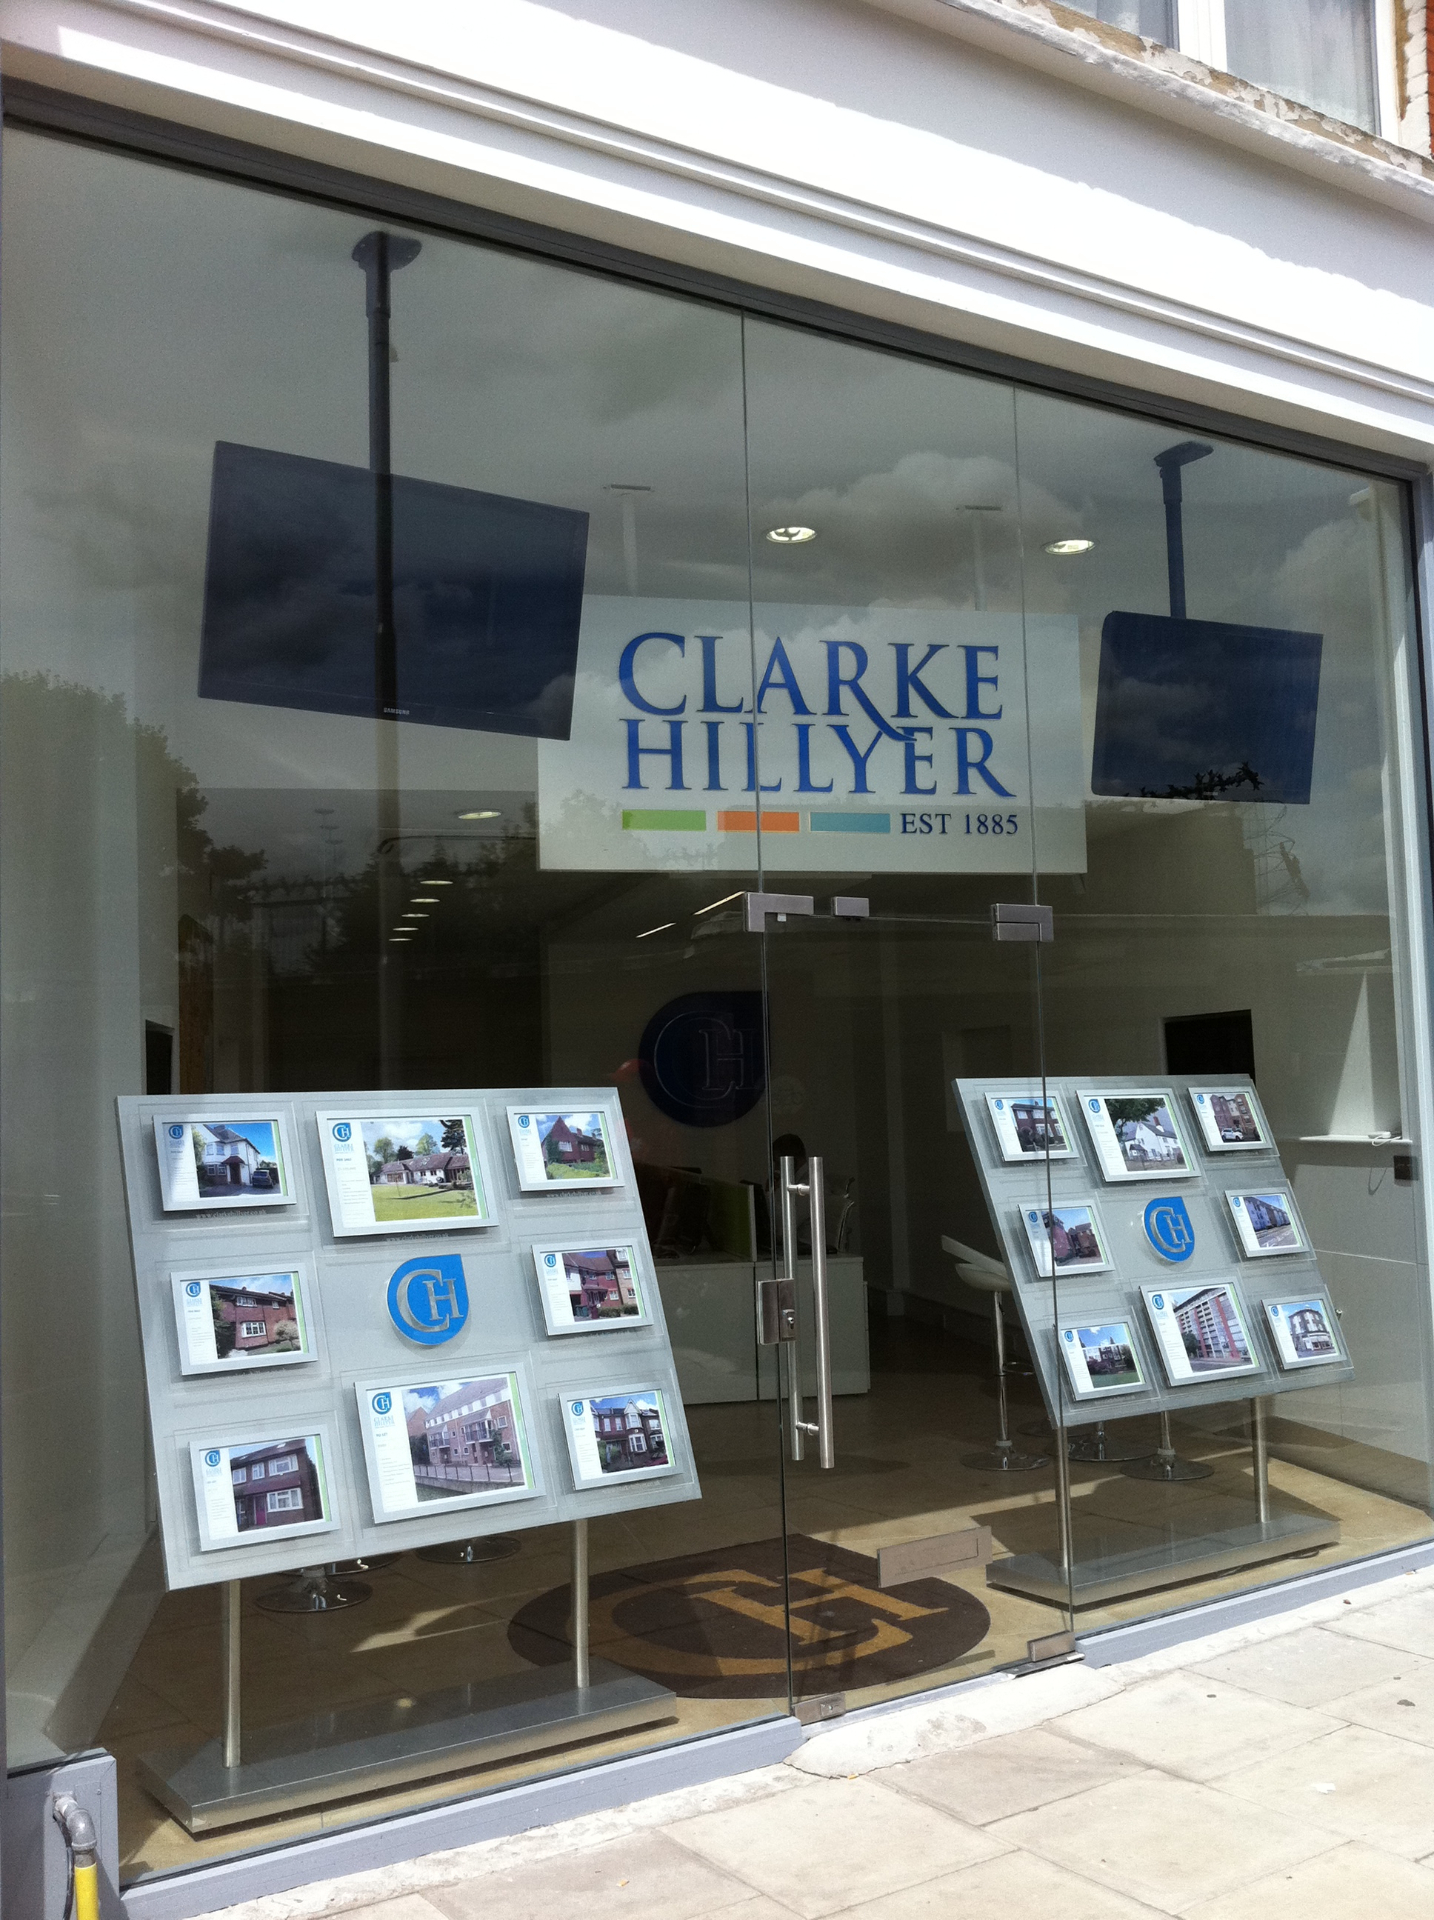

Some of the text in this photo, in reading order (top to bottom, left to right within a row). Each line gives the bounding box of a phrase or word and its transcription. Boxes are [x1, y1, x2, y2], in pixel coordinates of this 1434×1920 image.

[617, 632, 1003, 741] CLARKE
[618, 718, 1017, 798] HILLYER
[900, 812, 1019, 835] EST 1885
[1149, 1206, 1193, 1254] CH
[396, 1268, 464, 1333] CH
